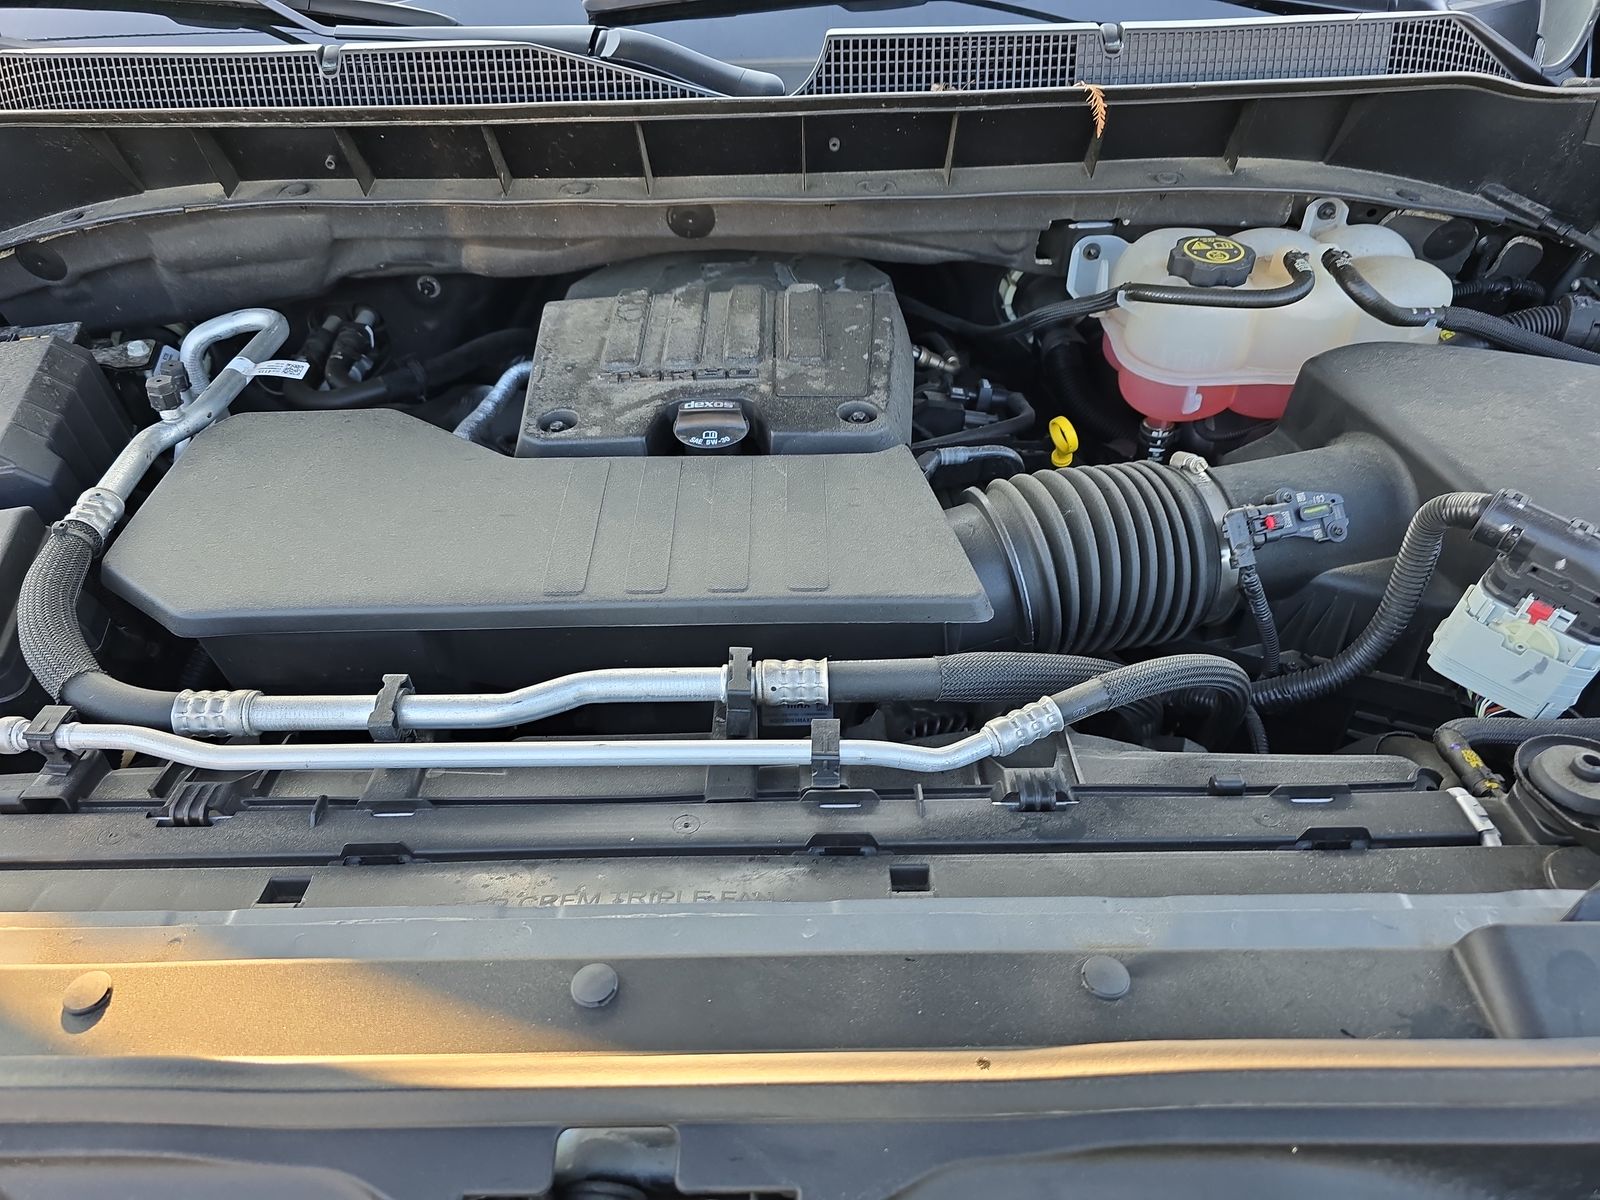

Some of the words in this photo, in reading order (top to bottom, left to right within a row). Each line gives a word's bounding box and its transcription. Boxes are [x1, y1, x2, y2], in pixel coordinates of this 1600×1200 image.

[684, 401, 735, 409] dexos
[689, 436, 704, 445] SAE
[706, 436, 731, 446] 5W-30
